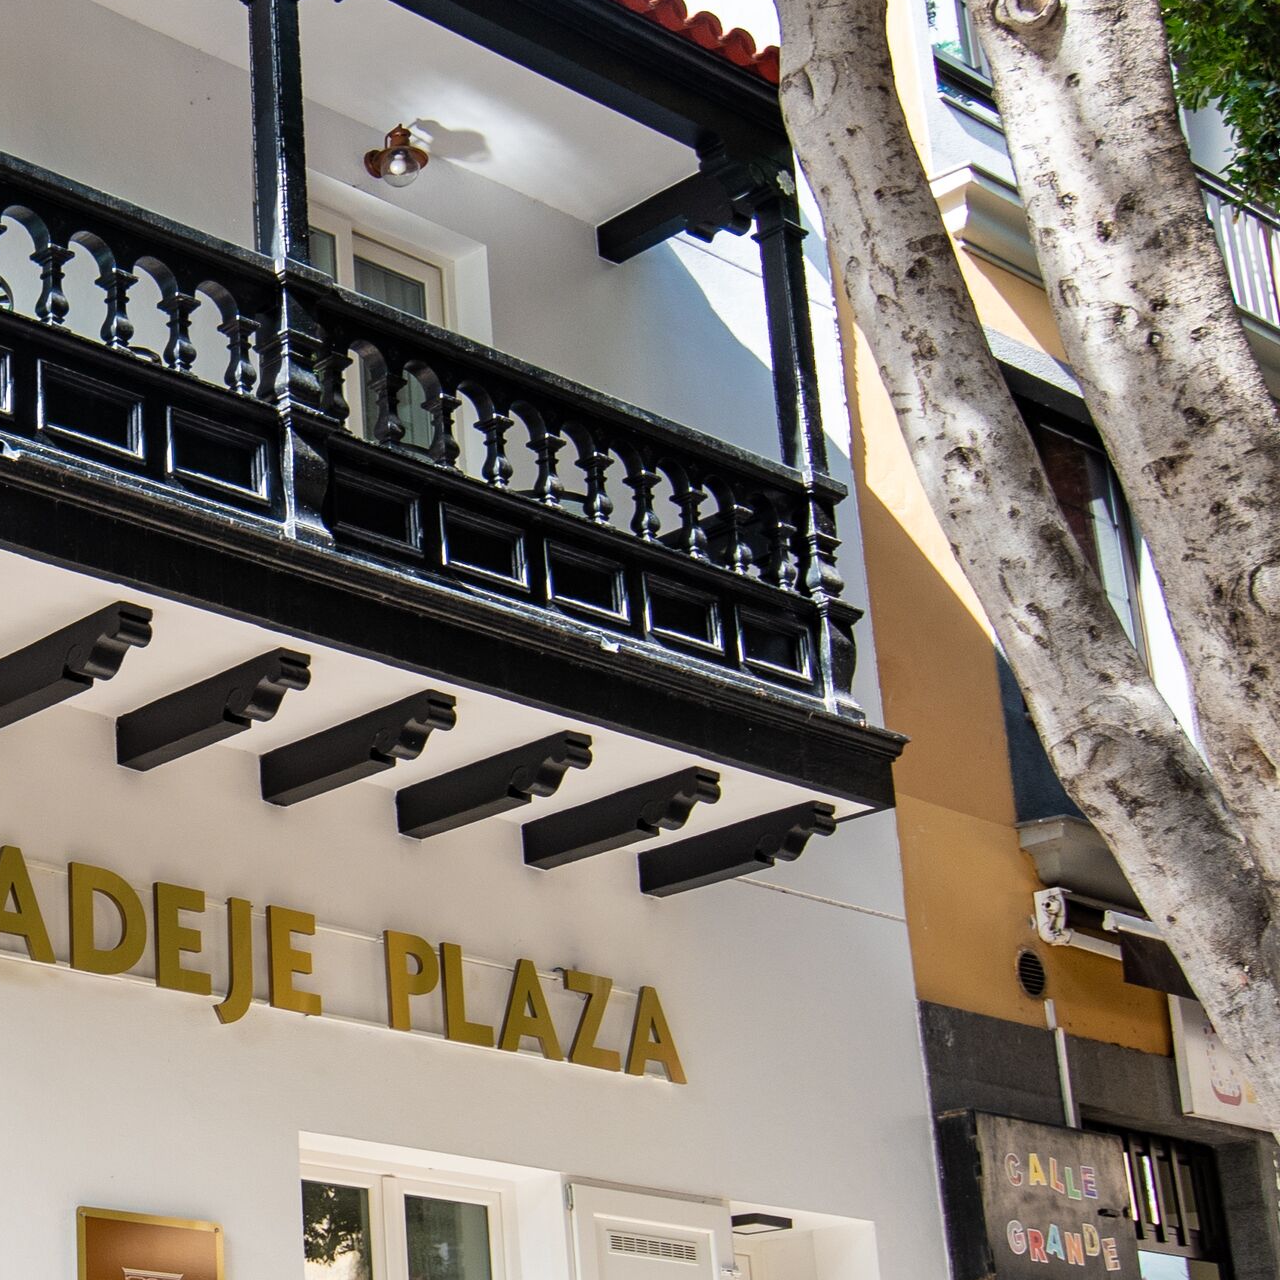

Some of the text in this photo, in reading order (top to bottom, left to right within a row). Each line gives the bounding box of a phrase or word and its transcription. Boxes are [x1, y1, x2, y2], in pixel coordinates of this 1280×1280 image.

[382, 929, 687, 1084] PLAZA
[1004, 1152, 1099, 1201] CALLE
[1006, 1219, 1121, 1271] GRANDE
